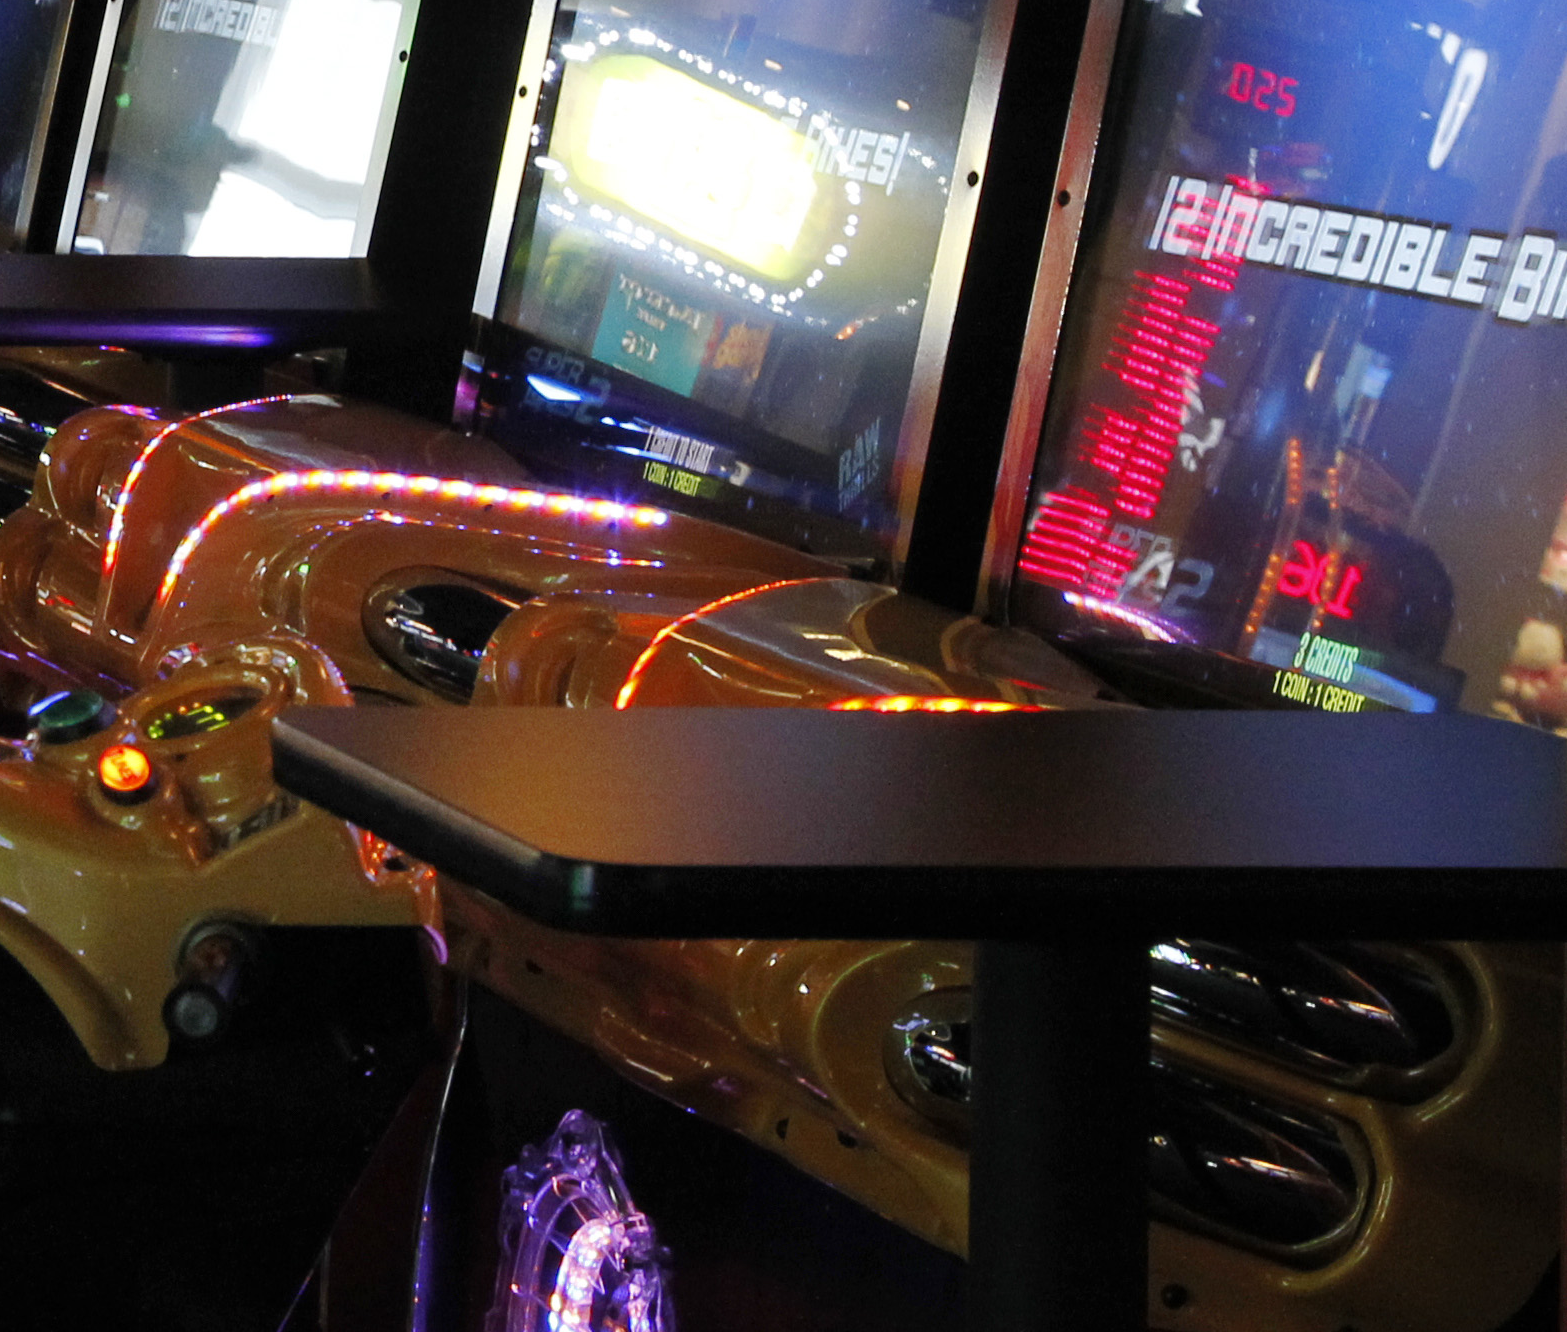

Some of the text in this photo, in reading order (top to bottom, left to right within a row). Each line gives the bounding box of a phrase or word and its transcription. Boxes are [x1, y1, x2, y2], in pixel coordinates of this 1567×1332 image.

[1149, 176, 1208, 255] 12
[1201, 183, 1504, 305] INCREDIBLE
[685, 439, 715, 474] START
[673, 470, 701, 497] CREDIT
[1294, 631, 1360, 684] 3 CREDITS
[1273, 670, 1281, 694] 1
[1281, 672, 1311, 703] COIN
[1314, 683, 1323, 707] 1
[1322, 685, 1366, 713] CREDIT
